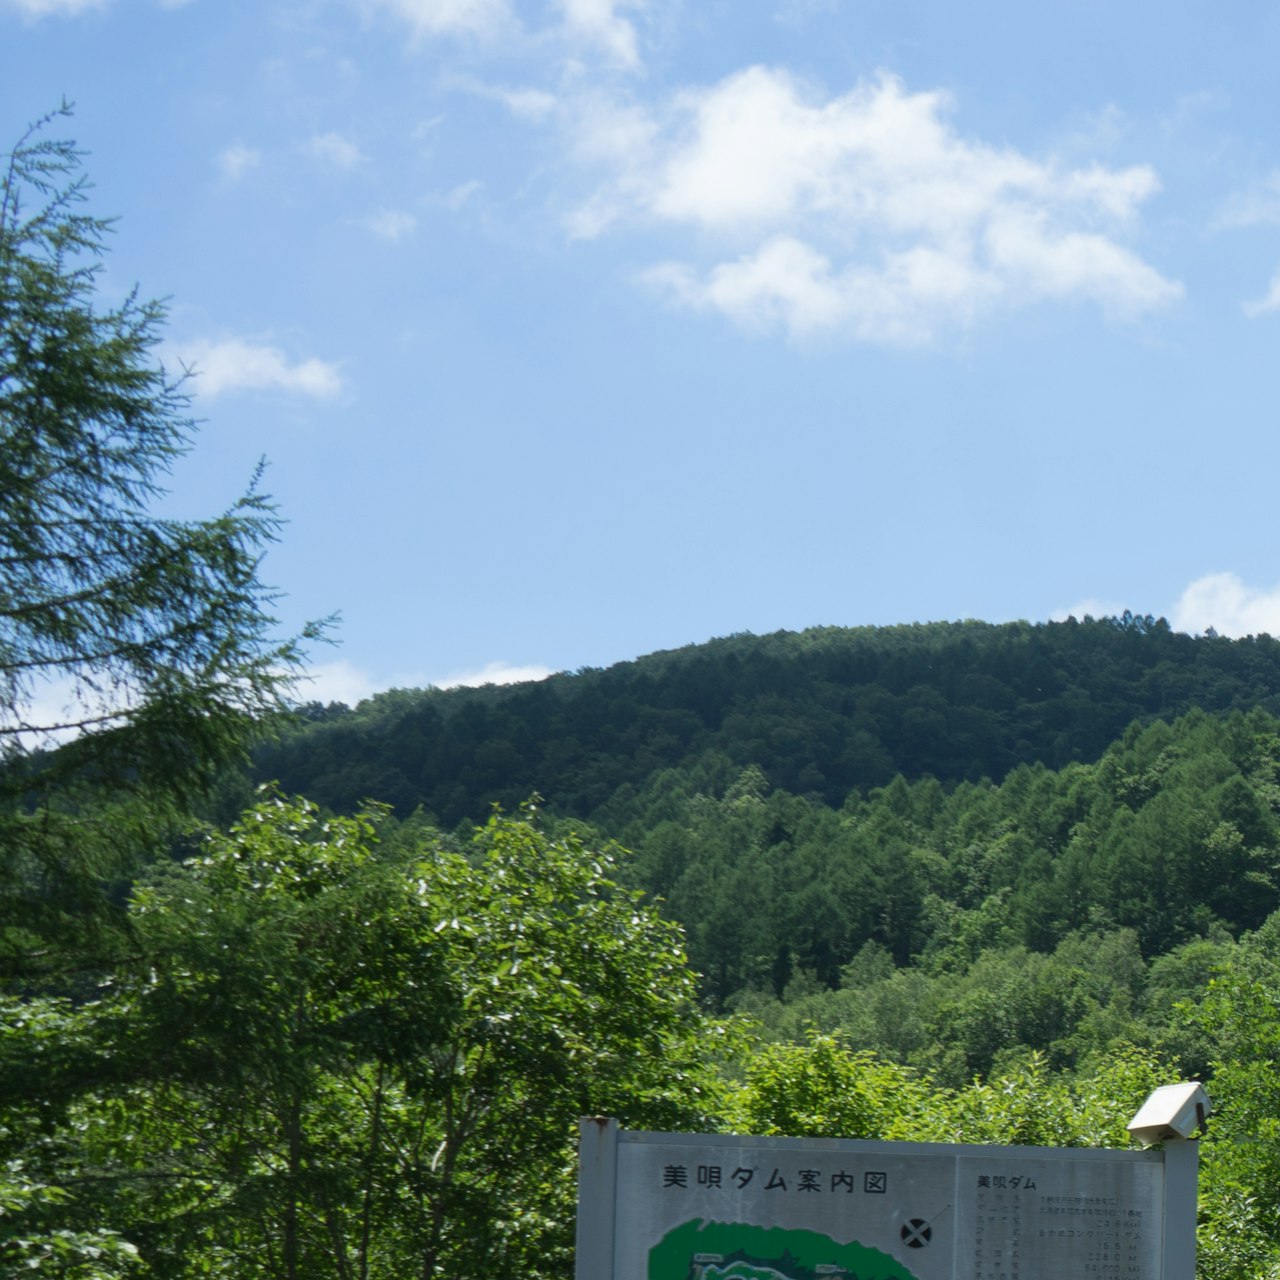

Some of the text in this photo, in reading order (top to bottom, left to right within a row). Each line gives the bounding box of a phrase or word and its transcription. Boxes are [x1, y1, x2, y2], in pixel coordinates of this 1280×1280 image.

[663, 1164, 888, 1194] 美唄ダム案内図
[976, 1175, 1037, 1191] 美唄ダム
